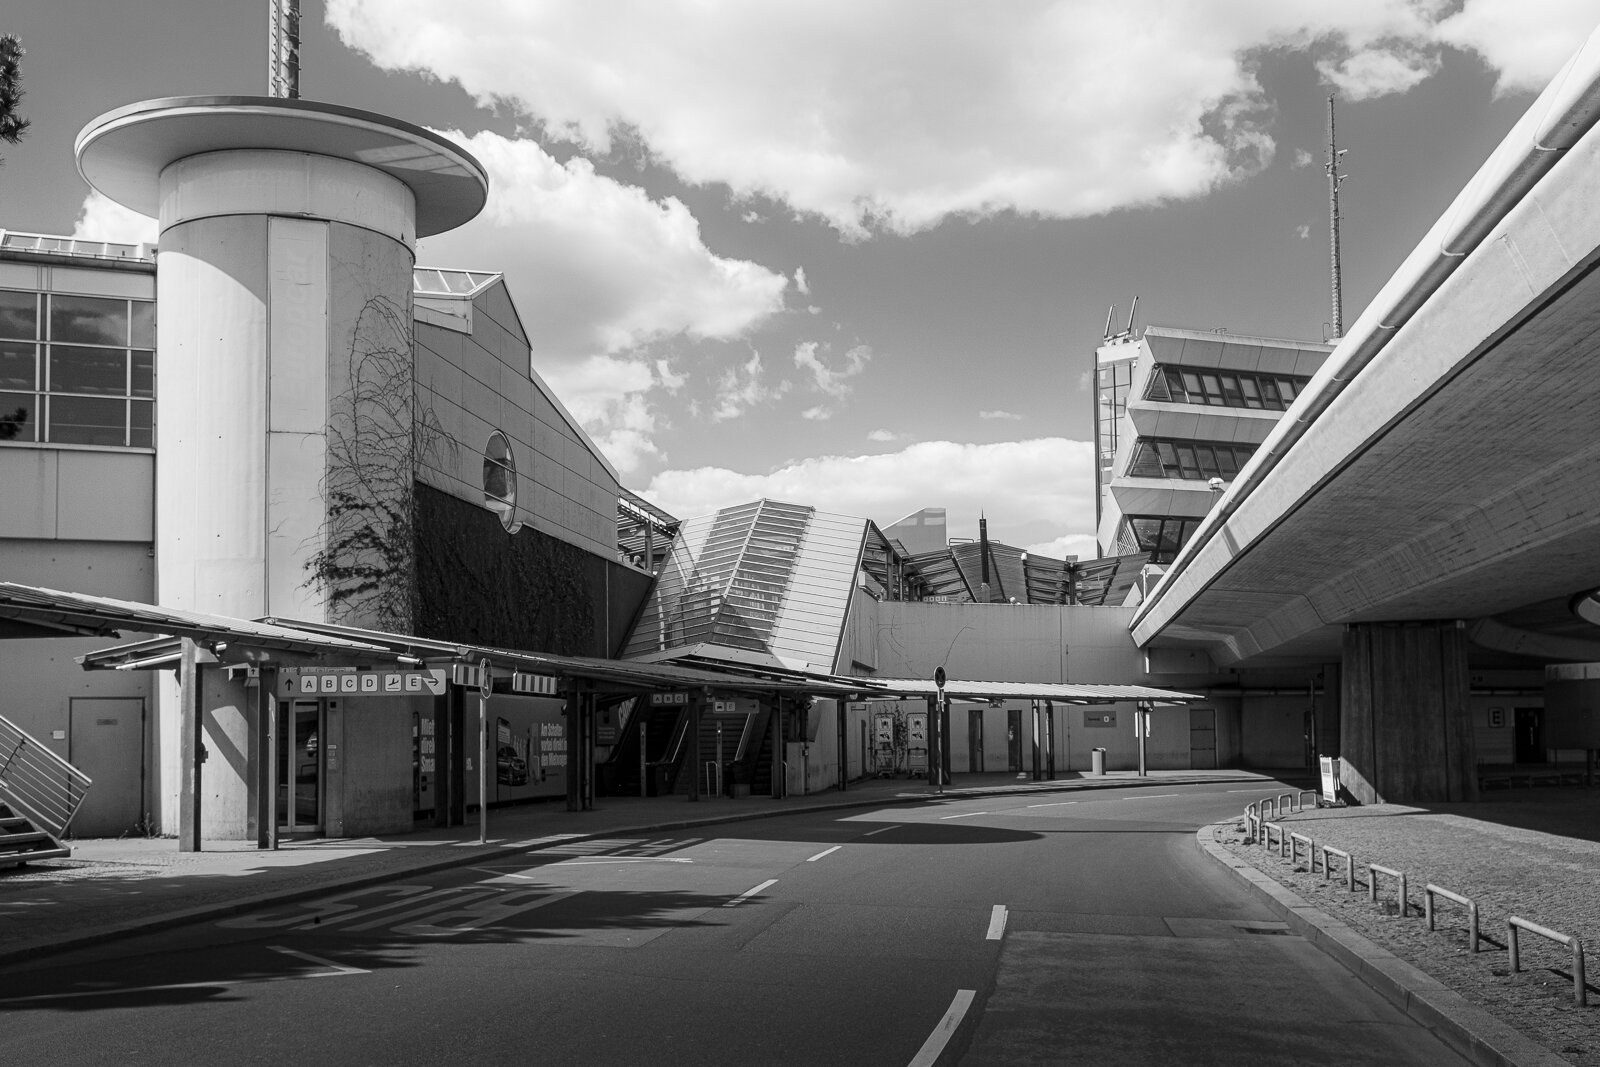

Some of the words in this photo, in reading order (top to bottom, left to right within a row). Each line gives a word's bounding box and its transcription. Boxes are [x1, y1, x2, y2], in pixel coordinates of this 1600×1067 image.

[305, 680, 313, 689] A
[326, 680, 333, 688] B
[345, 679, 353, 688] C
[366, 679, 374, 688] D
[410, 678, 418, 687] E
[1493, 711, 1500, 724] E
[541, 722, 547, 737] Am
